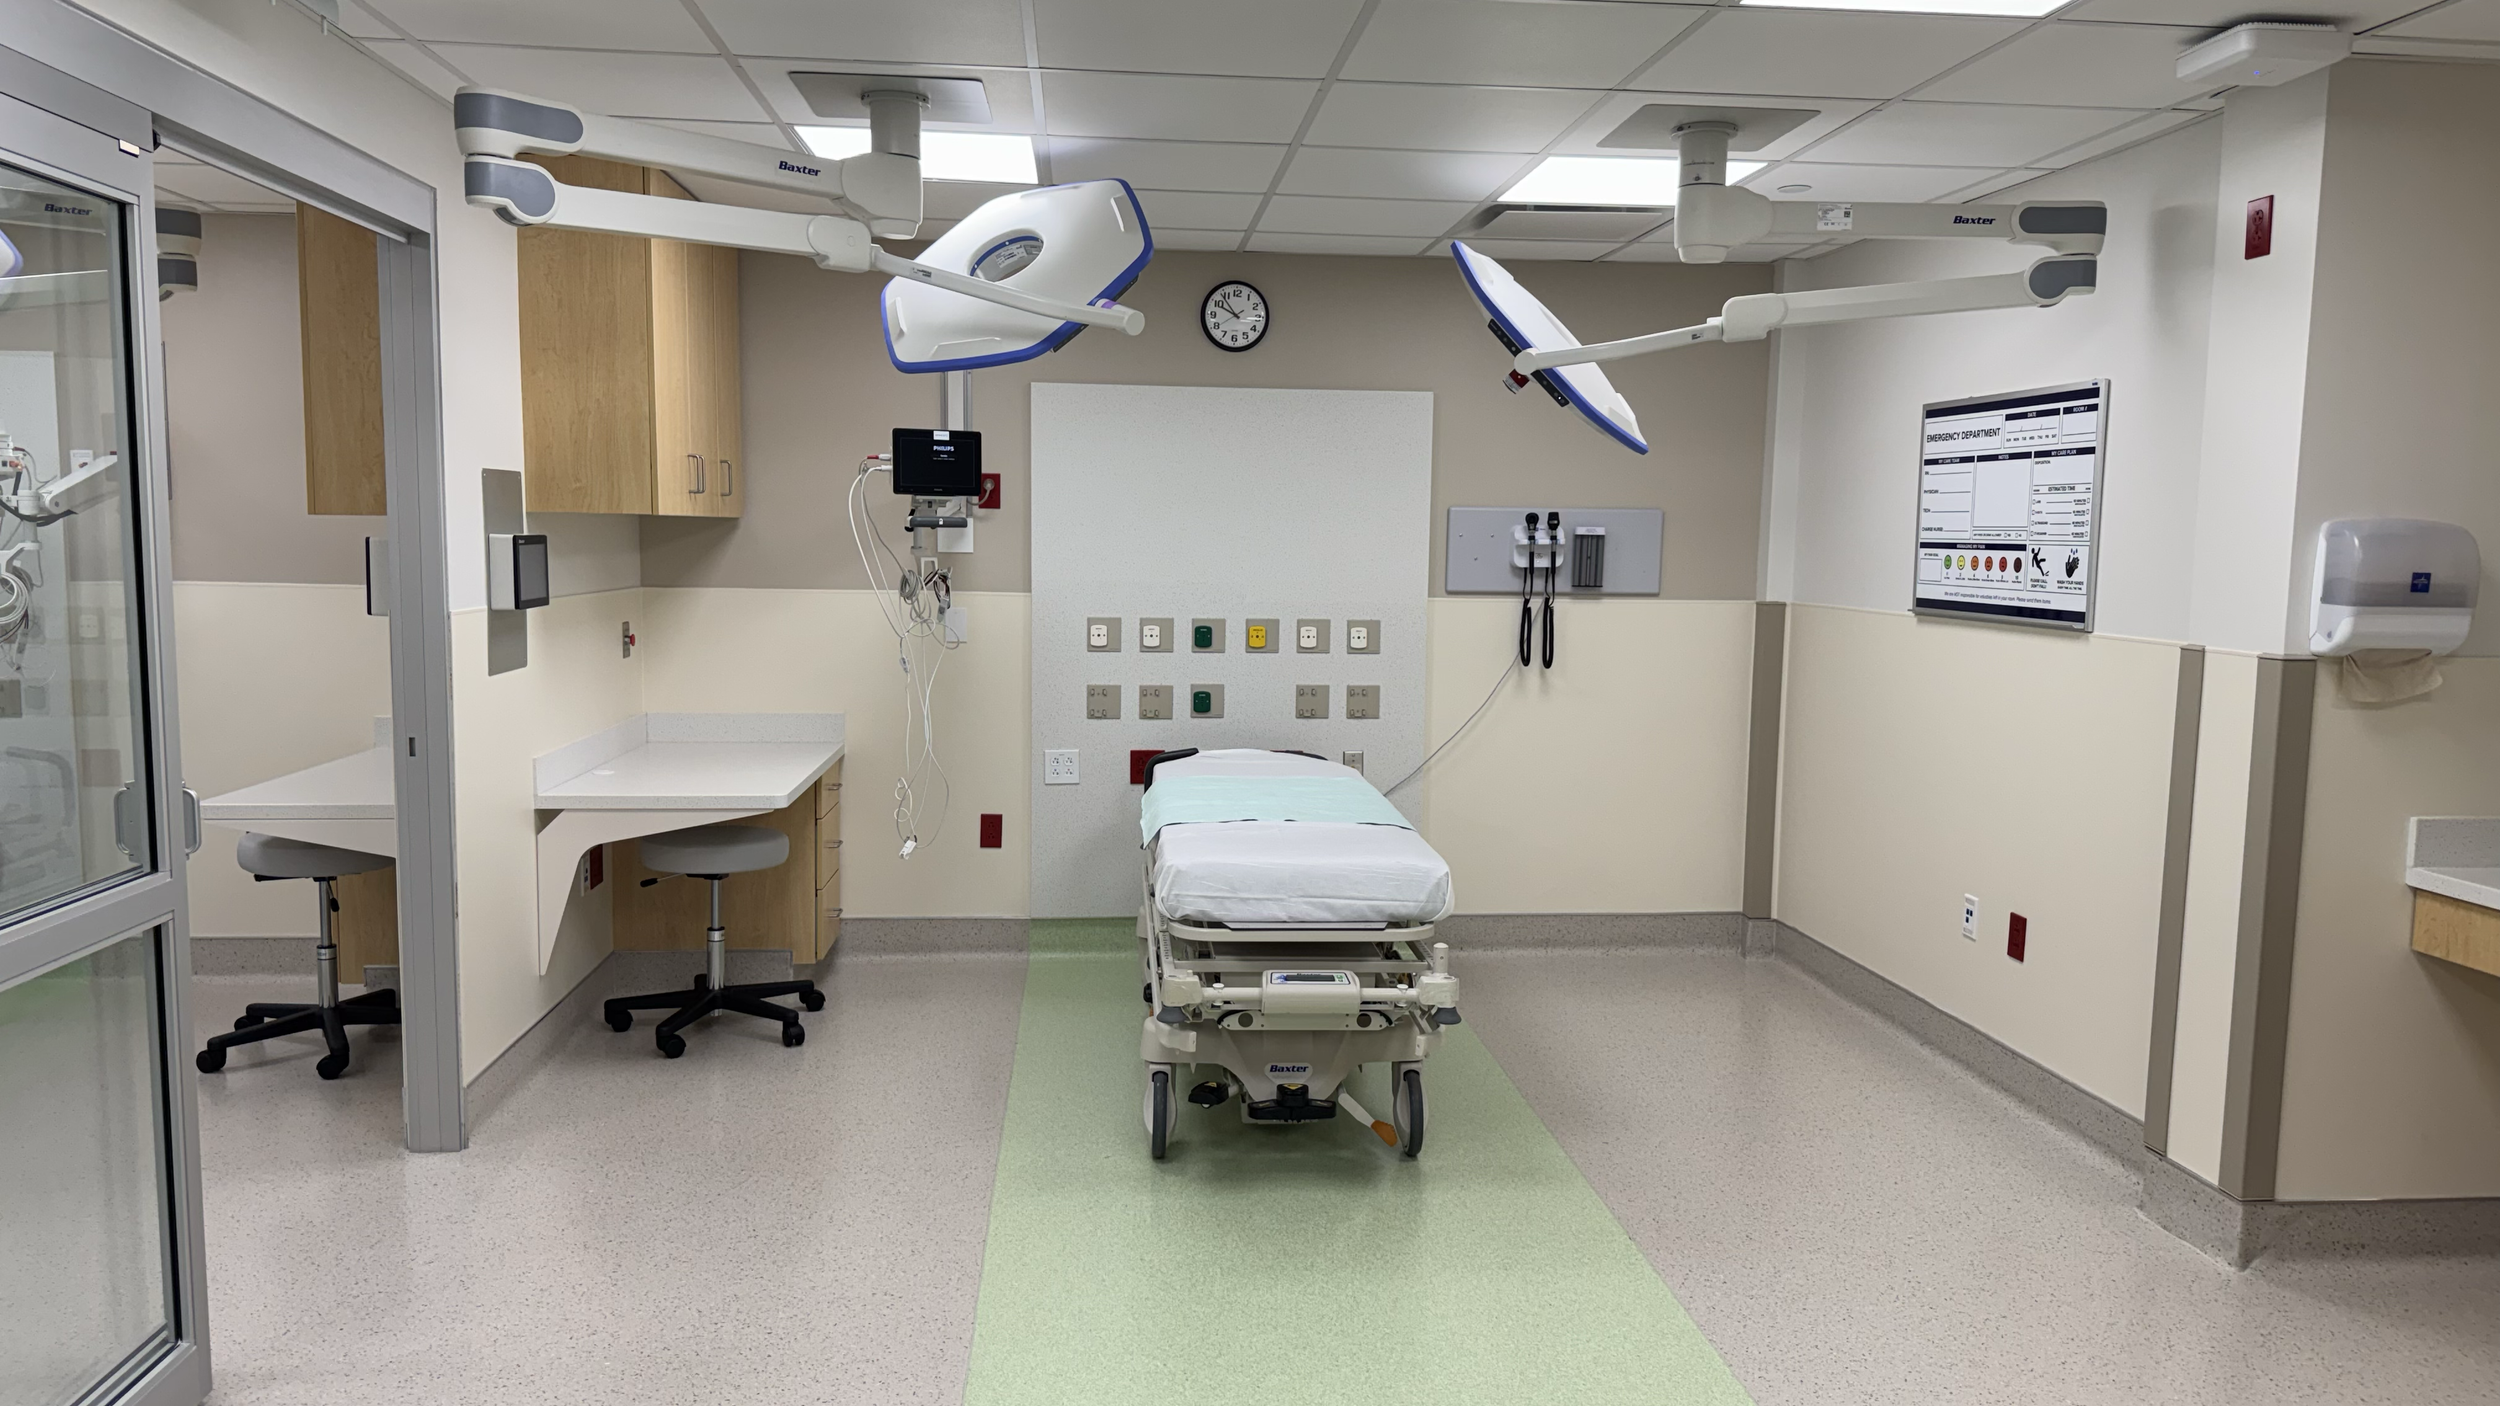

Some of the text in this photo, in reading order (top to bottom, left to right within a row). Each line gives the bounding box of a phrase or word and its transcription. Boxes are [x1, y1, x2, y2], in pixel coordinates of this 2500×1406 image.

[779, 160, 822, 176] Baxter
[44, 203, 93, 216] Baxter
[1953, 215, 1996, 225] Baxter
[1233, 289, 1242, 298] 12
[1214, 300, 1224, 308] 10
[1252, 302, 1258, 310] 2
[1210, 311, 1216, 319] 9
[1213, 322, 1220, 330] 8
[1250, 324, 1256, 332] 4
[1221, 330, 1227, 338] 7
[1231, 334, 1238, 342] 6
[1242, 332, 1248, 340] 5
[1926, 428, 2000, 443] EMERGENCY DEPARTMENT
[1270, 1064, 1309, 1072] Baxter
